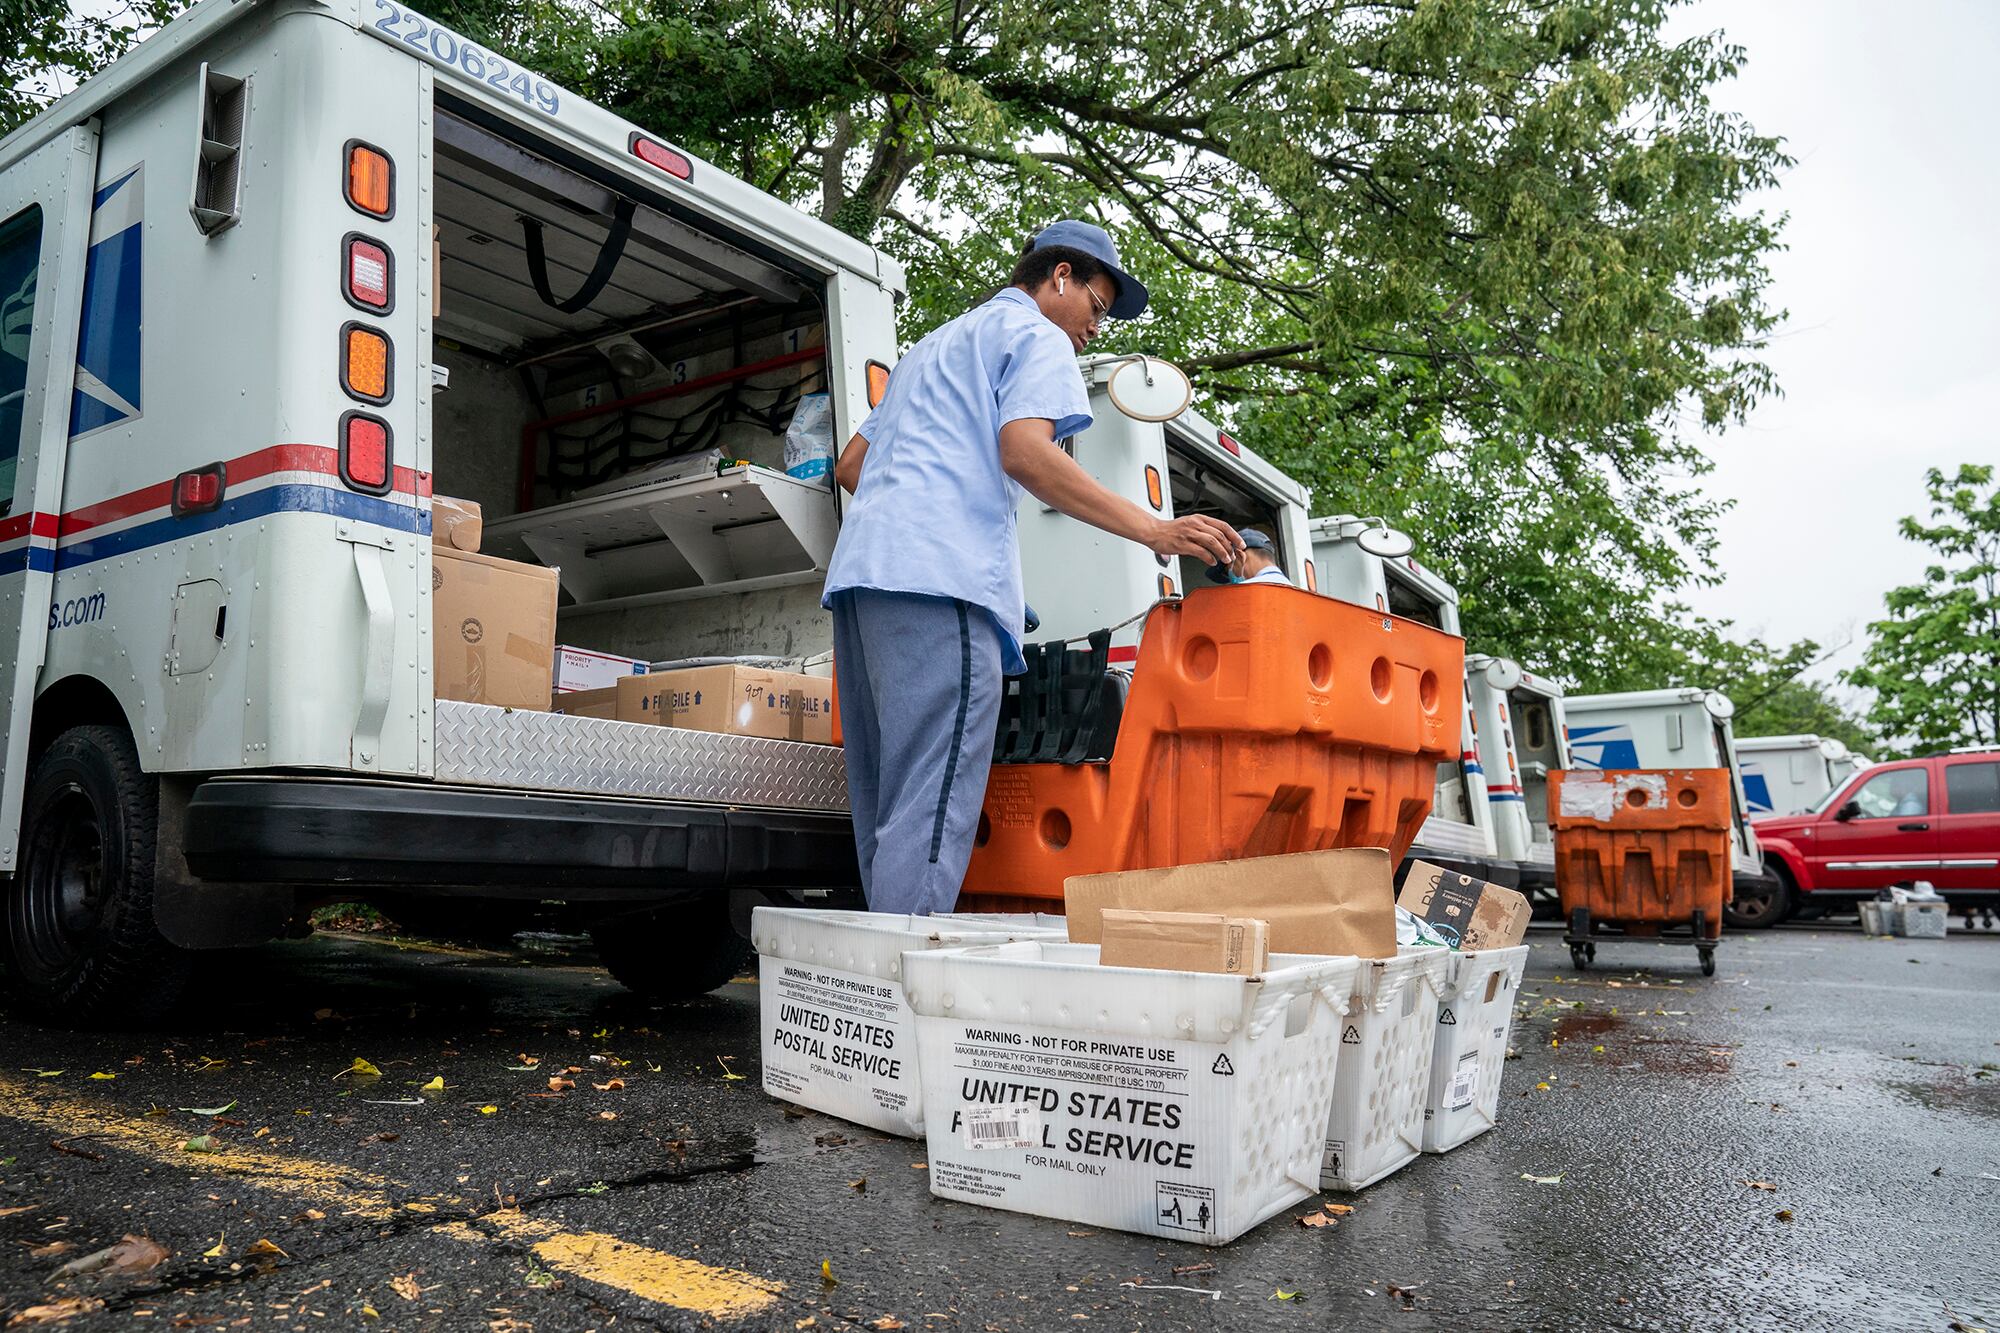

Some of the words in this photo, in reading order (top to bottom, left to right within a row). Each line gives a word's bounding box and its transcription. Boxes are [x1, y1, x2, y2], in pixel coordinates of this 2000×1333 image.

[375, 0, 560, 116] 2206249
[788, 330, 799, 352] 1
[674, 362, 687, 385] 3
[585, 386, 597, 409] 5
[564, 653, 592, 664] PRIORITY
[570, 661, 585, 669] MAIL
[784, 966, 812, 981] WARNING
[816, 974, 830, 986] NOT
[831, 977, 846, 990] FOR
[846, 981, 875, 996] PRIVATE
[876, 987, 892, 999] USE
[859, 998, 874, 1008] POSTAL
[875, 1001, 898, 1013] PROPERTY
[781, 1004, 830, 1033] UNITED
[833, 1017, 895, 1050] STATES
[774, 1028, 827, 1060] POSTAL
[831, 1045, 901, 1080] SERVICE
[965, 1028, 1021, 1045] WARNING
[1032, 1036, 1057, 1049] NOT
[1061, 1039, 1087, 1053] FOR
[1090, 1042, 1144, 1059] PRIVATE
[1148, 1049, 1176, 1063] USE
[810, 1063, 822, 1074] FOR
[822, 1067, 836, 1079] MAIL
[837, 1071, 853, 1083] ONLY
[954, 1046, 988, 1057] MAXIMUM
[988, 1050, 1019, 1061] PENALTY
[1020, 1054, 1036, 1063] FOR
[1036, 1056, 1059, 1066] THEFT
[1060, 1058, 1072, 1067] OR
[1073, 1060, 1101, 1072] MISUSE
[1102, 1063, 1113, 1072] OF
[1114, 1065, 1144, 1076] POSTAL
[1145, 1068, 1188, 1081] PROPERTY
[972, 1058, 994, 1069] $1,000
[994, 1061, 1010, 1070] FINE
[1010, 1064, 1026, 1072] AND
[1031, 1066, 1057, 1077] YEARS
[1057, 1069, 1114, 1084] IMPRISONMENT
[1114, 1077, 1126, 1087] (18
[1127, 1078, 1144, 1088] USC
[1145, 1079, 1165, 1092] 1707)
[962, 1077, 1059, 1112] UNITED
[1067, 1092, 1182, 1130] STATES
[1065, 1128, 1195, 1169] SERVICE
[936, 1159, 955, 1169] RETURN
[963, 1165, 987, 1175] NEAREST
[987, 1169, 1001, 1177] POST
[1002, 1172, 1021, 1181] OFFICE
[943, 1170, 962, 1179] REPORT
[963, 1174, 982, 1182] MISUSE
[1025, 1154, 1046, 1167] FOR
[1050, 1159, 1074, 1172] MAIL
[1077, 1162, 1107, 1176] ONLY
